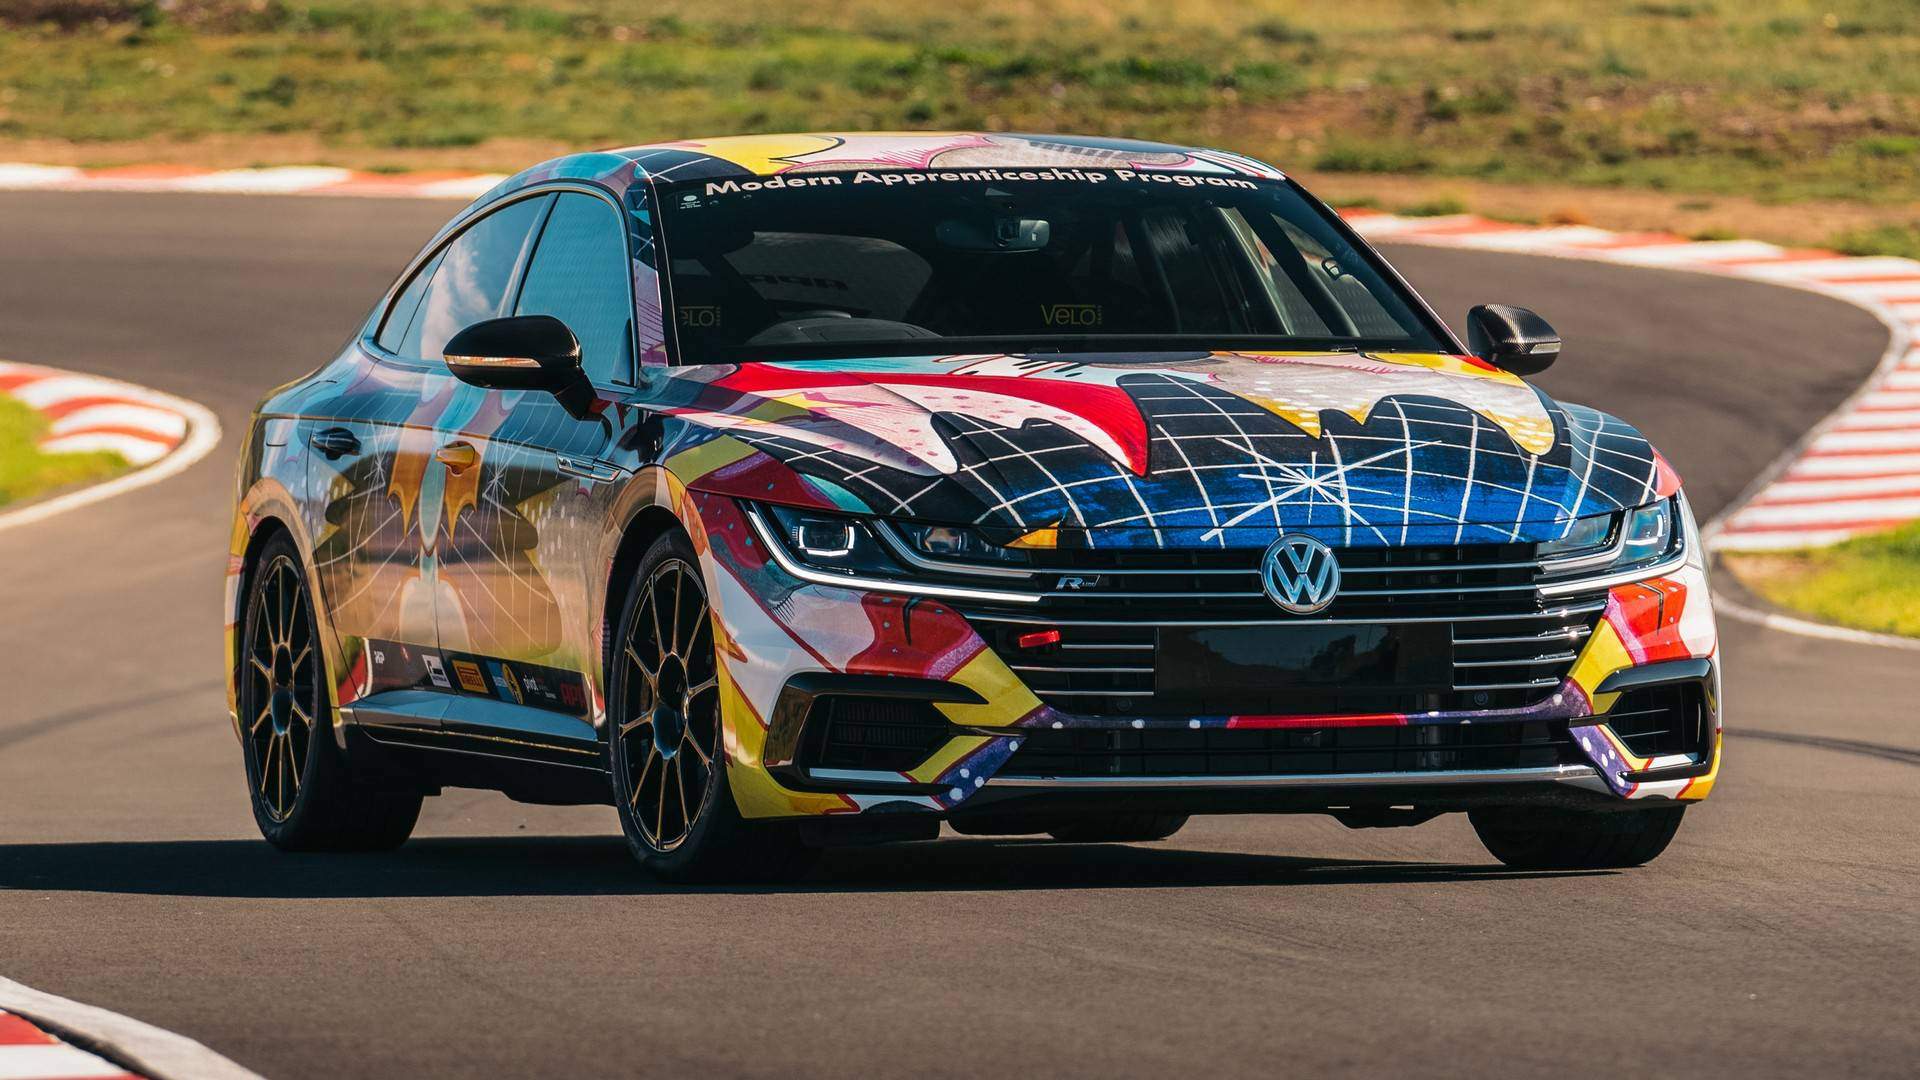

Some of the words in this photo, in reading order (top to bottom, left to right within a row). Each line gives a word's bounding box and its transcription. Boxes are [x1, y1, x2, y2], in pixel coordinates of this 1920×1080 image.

[706, 176, 843, 196] Modern
[853, 170, 1107, 187] Apprenticeship
[1113, 169, 1258, 190] Program
[1055, 576, 1083, 590] R
[1267, 539, 1335, 609] VW
